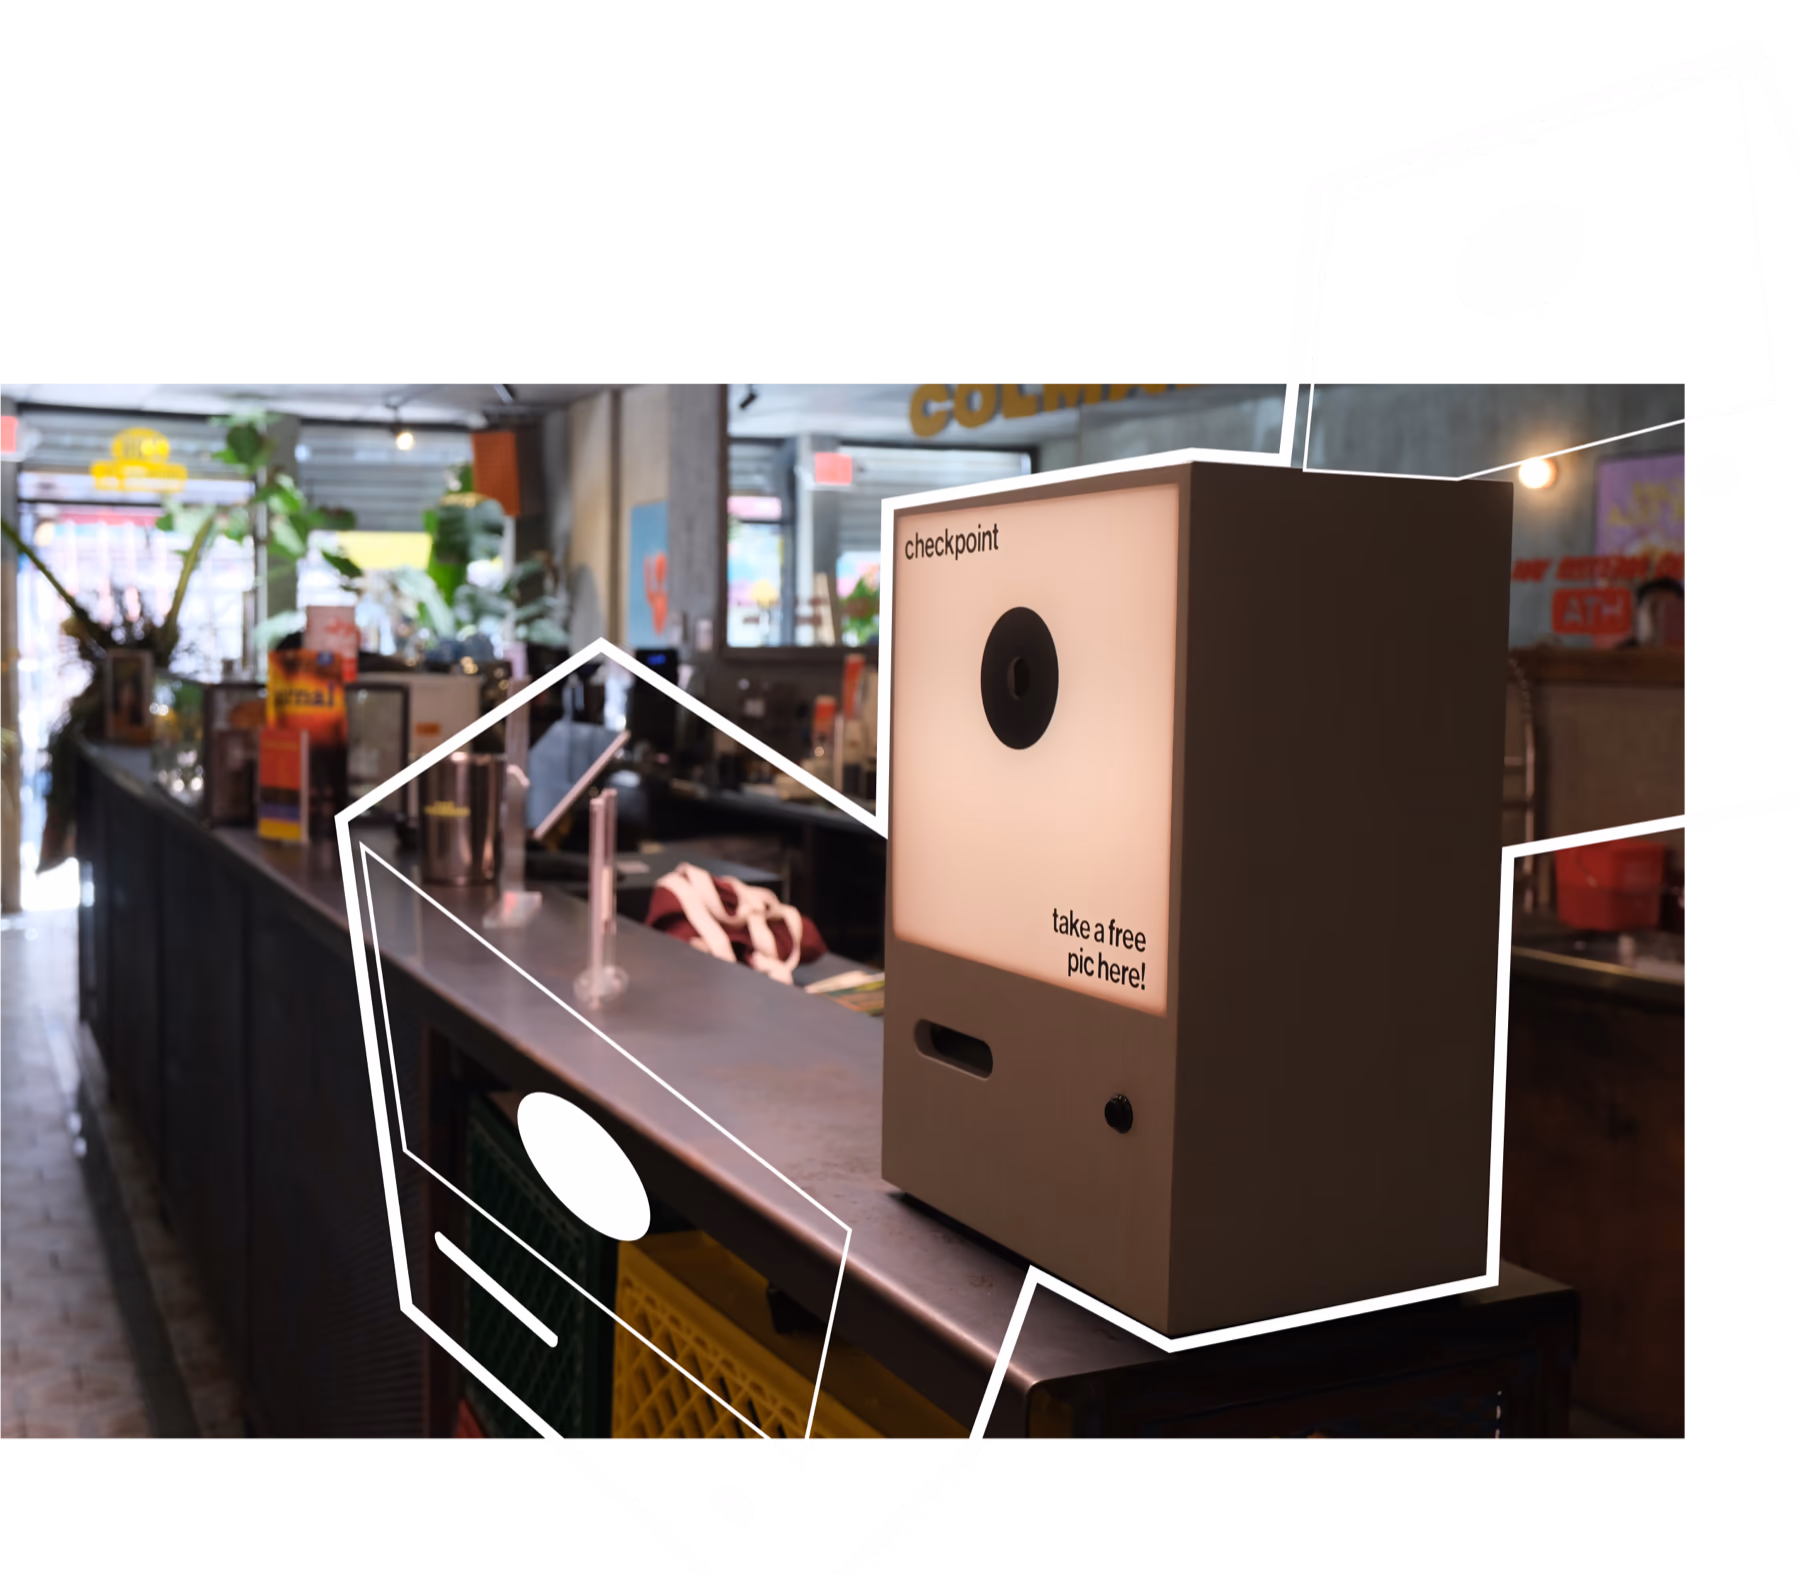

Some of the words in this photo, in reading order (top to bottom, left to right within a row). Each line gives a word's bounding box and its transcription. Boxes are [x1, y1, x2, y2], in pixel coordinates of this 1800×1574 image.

[910, 383, 1206, 437] COLM
[905, 523, 999, 561] checkpoint
[1052, 907, 1091, 940] take
[1094, 922, 1105, 944] a
[1108, 918, 1147, 953] free
[1067, 946, 1095, 978] pic
[1097, 951, 1146, 991] here!
